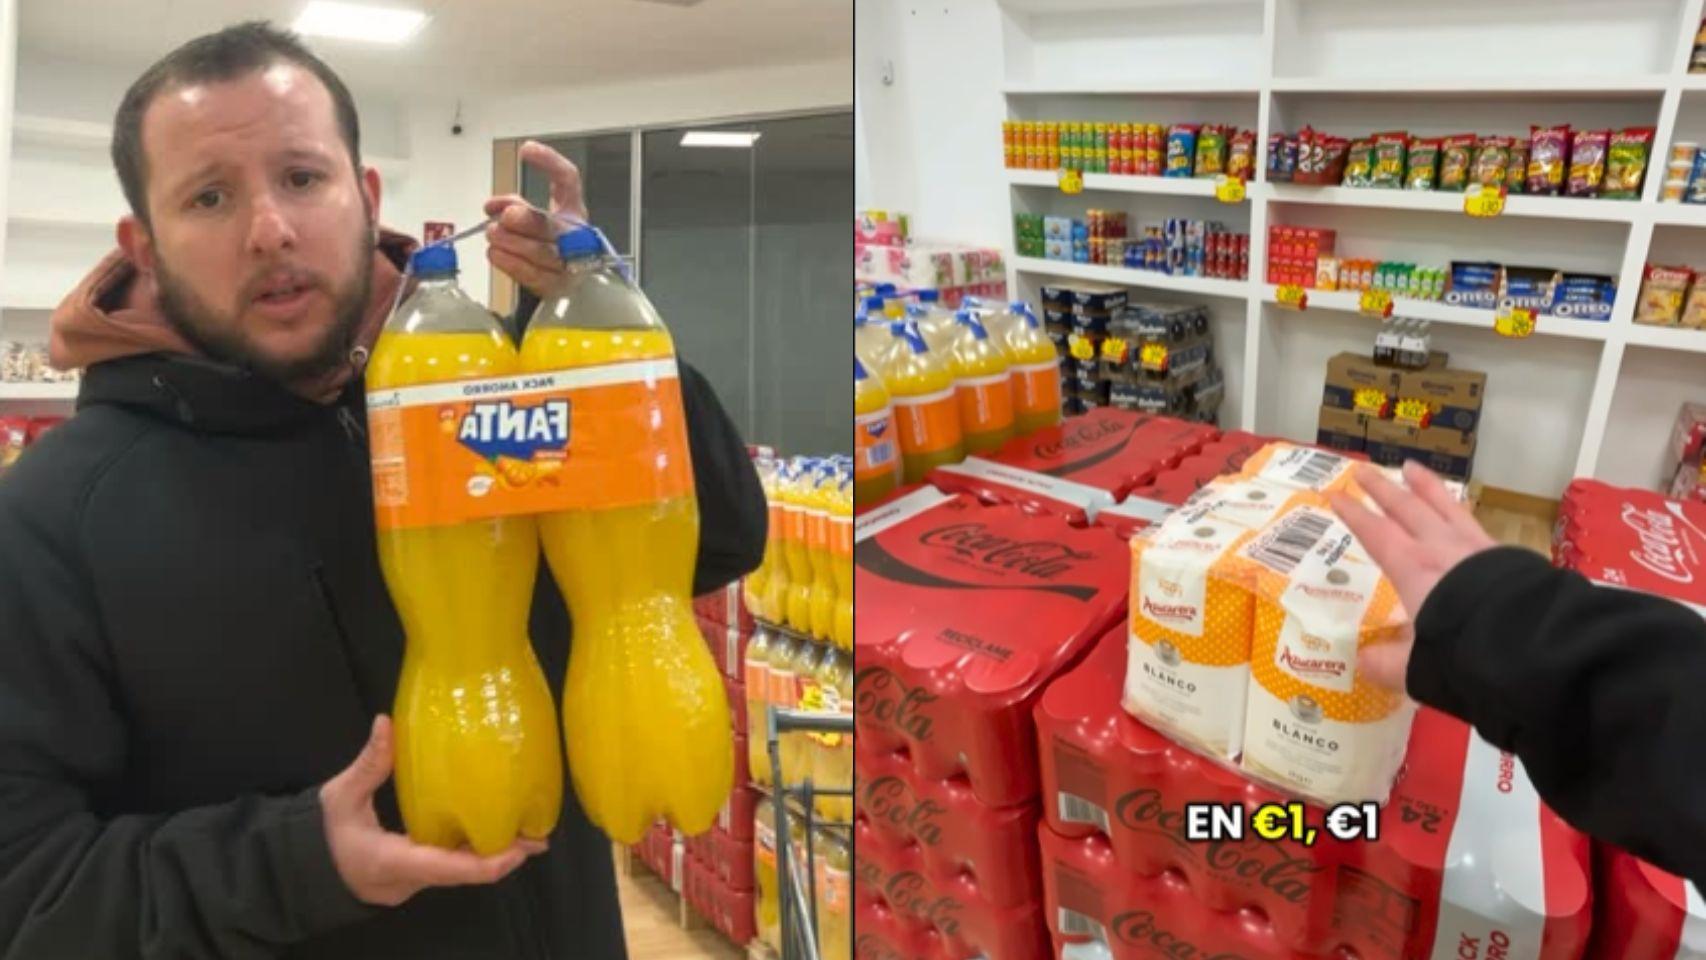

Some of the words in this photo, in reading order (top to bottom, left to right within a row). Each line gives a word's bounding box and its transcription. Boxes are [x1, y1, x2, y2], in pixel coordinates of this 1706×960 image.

[1556, 302, 1610, 316] OREO
[1280, 645, 1347, 675] Azucarera
[1143, 663, 1197, 693] BLANCO
[1273, 718, 1339, 751] BLANCO
[1400, 804, 1441, 834] 24
